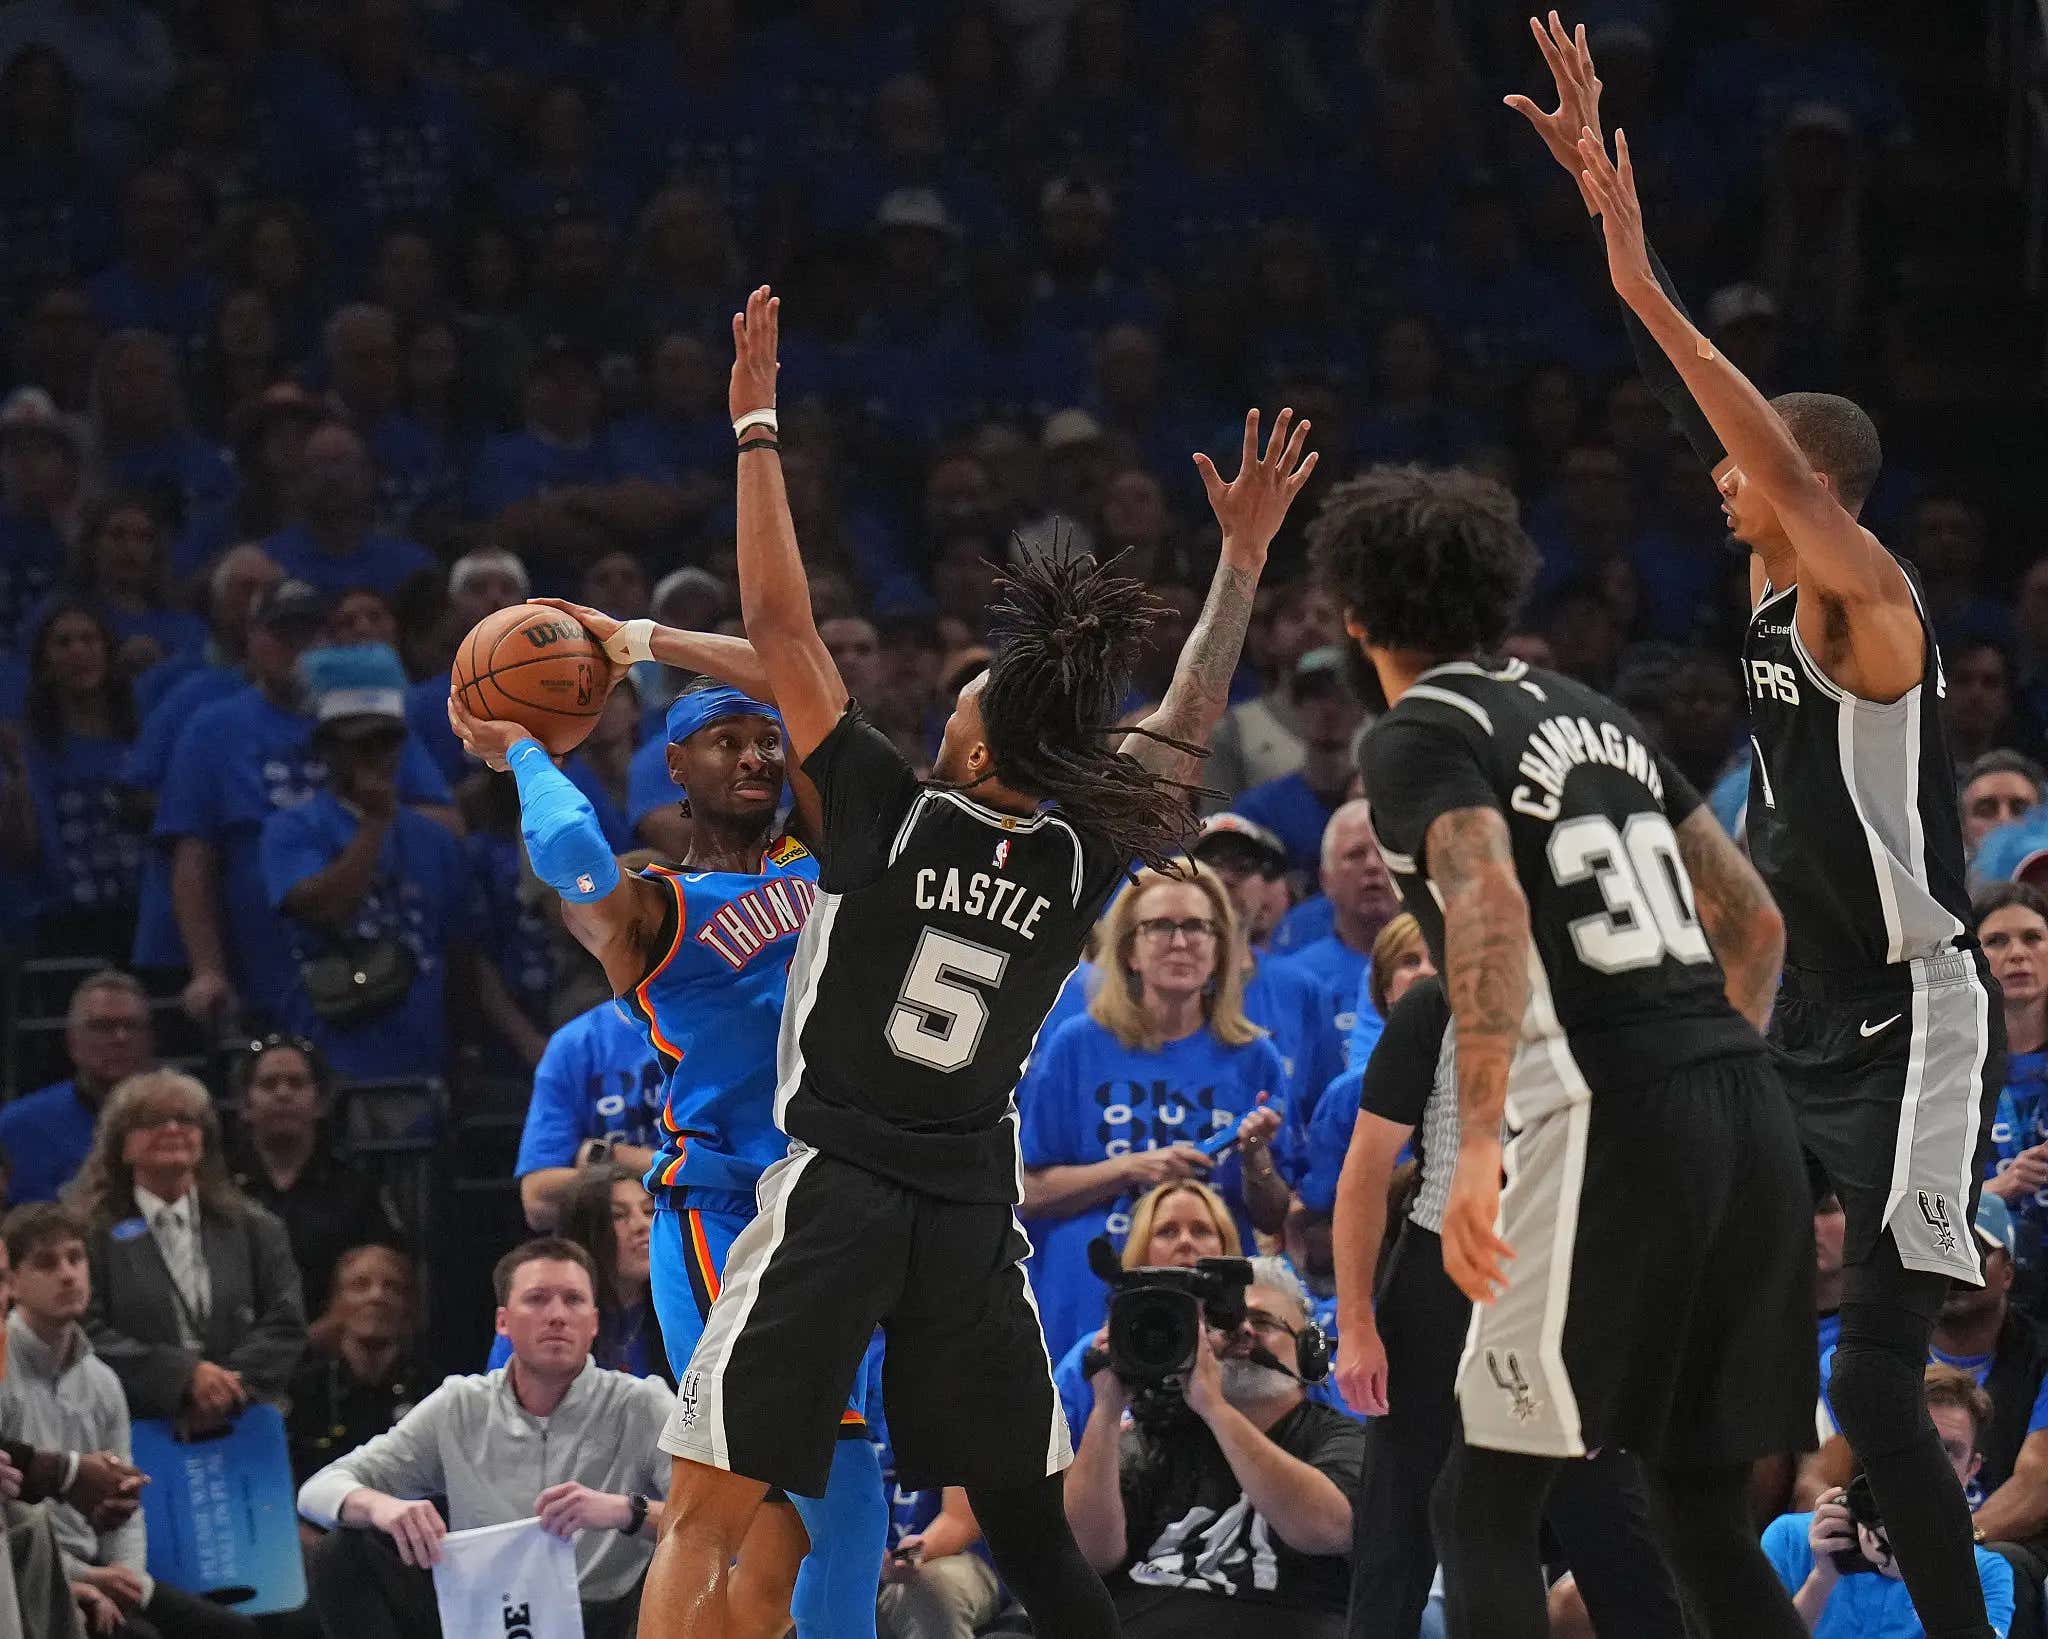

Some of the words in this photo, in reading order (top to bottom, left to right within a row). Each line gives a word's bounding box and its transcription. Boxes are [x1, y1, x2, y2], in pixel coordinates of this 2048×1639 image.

[695, 875, 818, 971] THUND
[915, 867, 1051, 940] CASTLE
[1546, 812, 1714, 975] 30
[883, 924, 1011, 1074] 5
